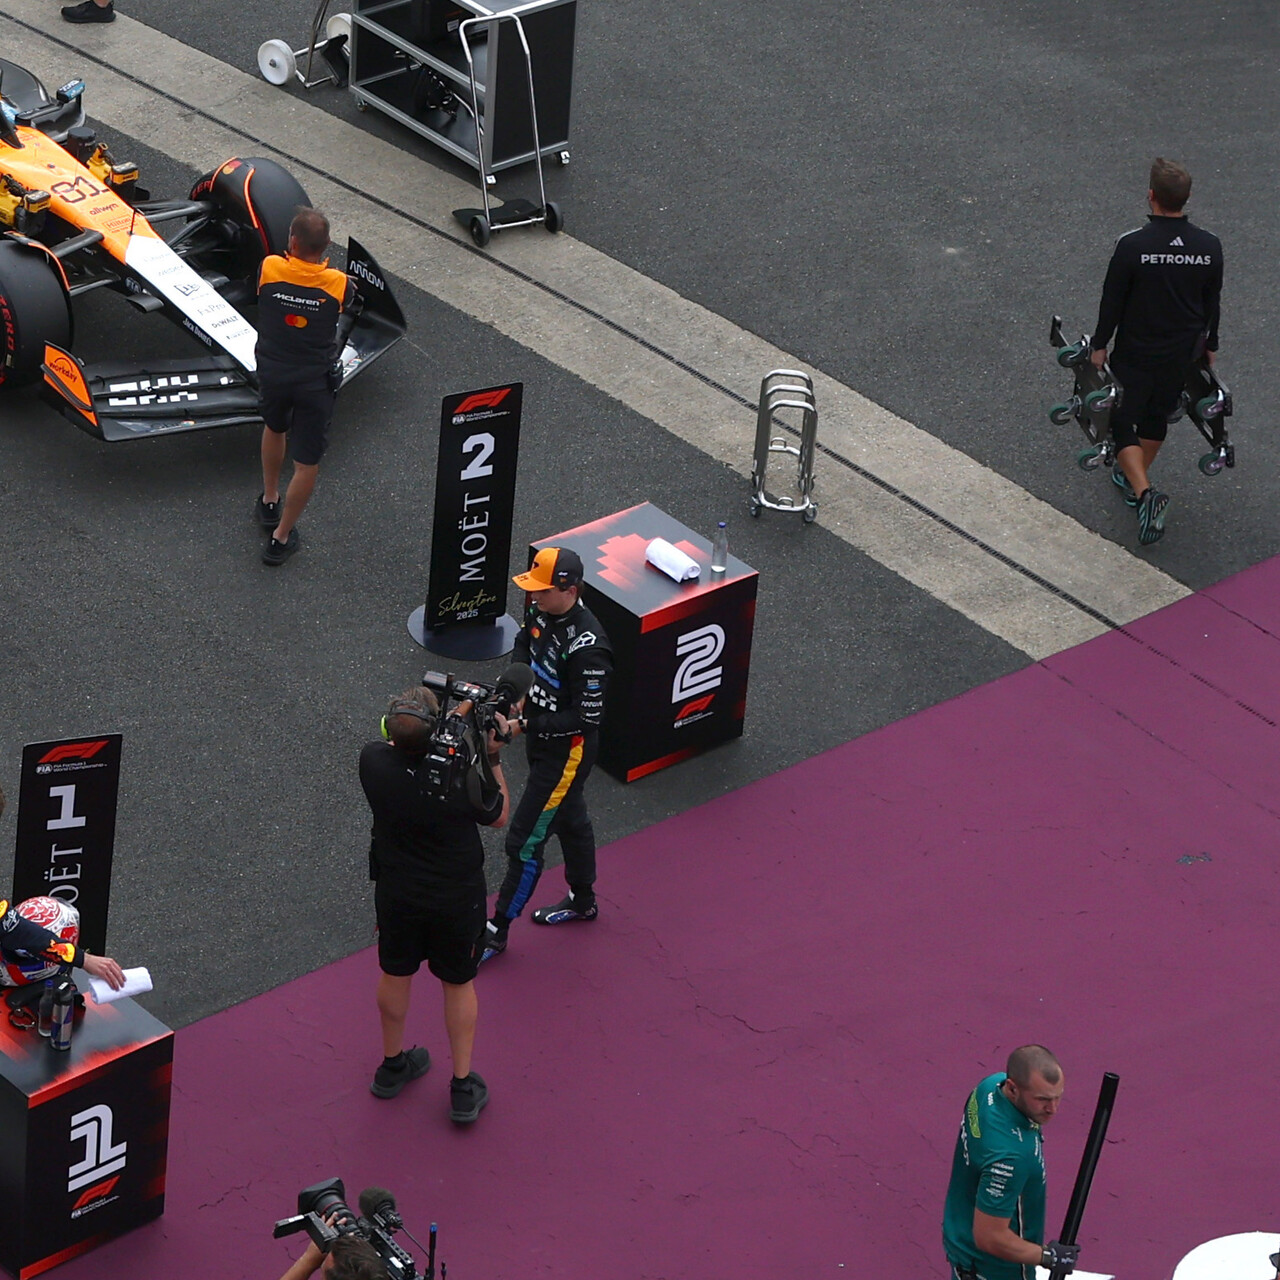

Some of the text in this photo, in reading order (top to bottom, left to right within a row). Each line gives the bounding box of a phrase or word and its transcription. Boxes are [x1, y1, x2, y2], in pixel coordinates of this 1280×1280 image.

[50, 175, 110, 204] 81
[89, 203, 119, 216] allwyn
[1141, 254, 1211, 266] PETRONAS
[349, 260, 385, 291] ARROW
[272, 292, 320, 307] McLaren
[48, 360, 78, 384] workday
[453, 388, 512, 414] F1
[460, 432, 495, 481] 2
[458, 492, 491, 583] MOËT
[438, 588, 498, 618] Silverstone
[456, 608, 479, 620] 2025
[672, 623, 726, 704] 2
[674, 693, 716, 720] F1
[37, 740, 110, 763] F1
[36, 765, 53, 775] FIA
[47, 783, 87, 831] 1
[43, 843, 83, 905] OËT
[68, 1104, 127, 1192] 1
[72, 1174, 121, 1210] F1
